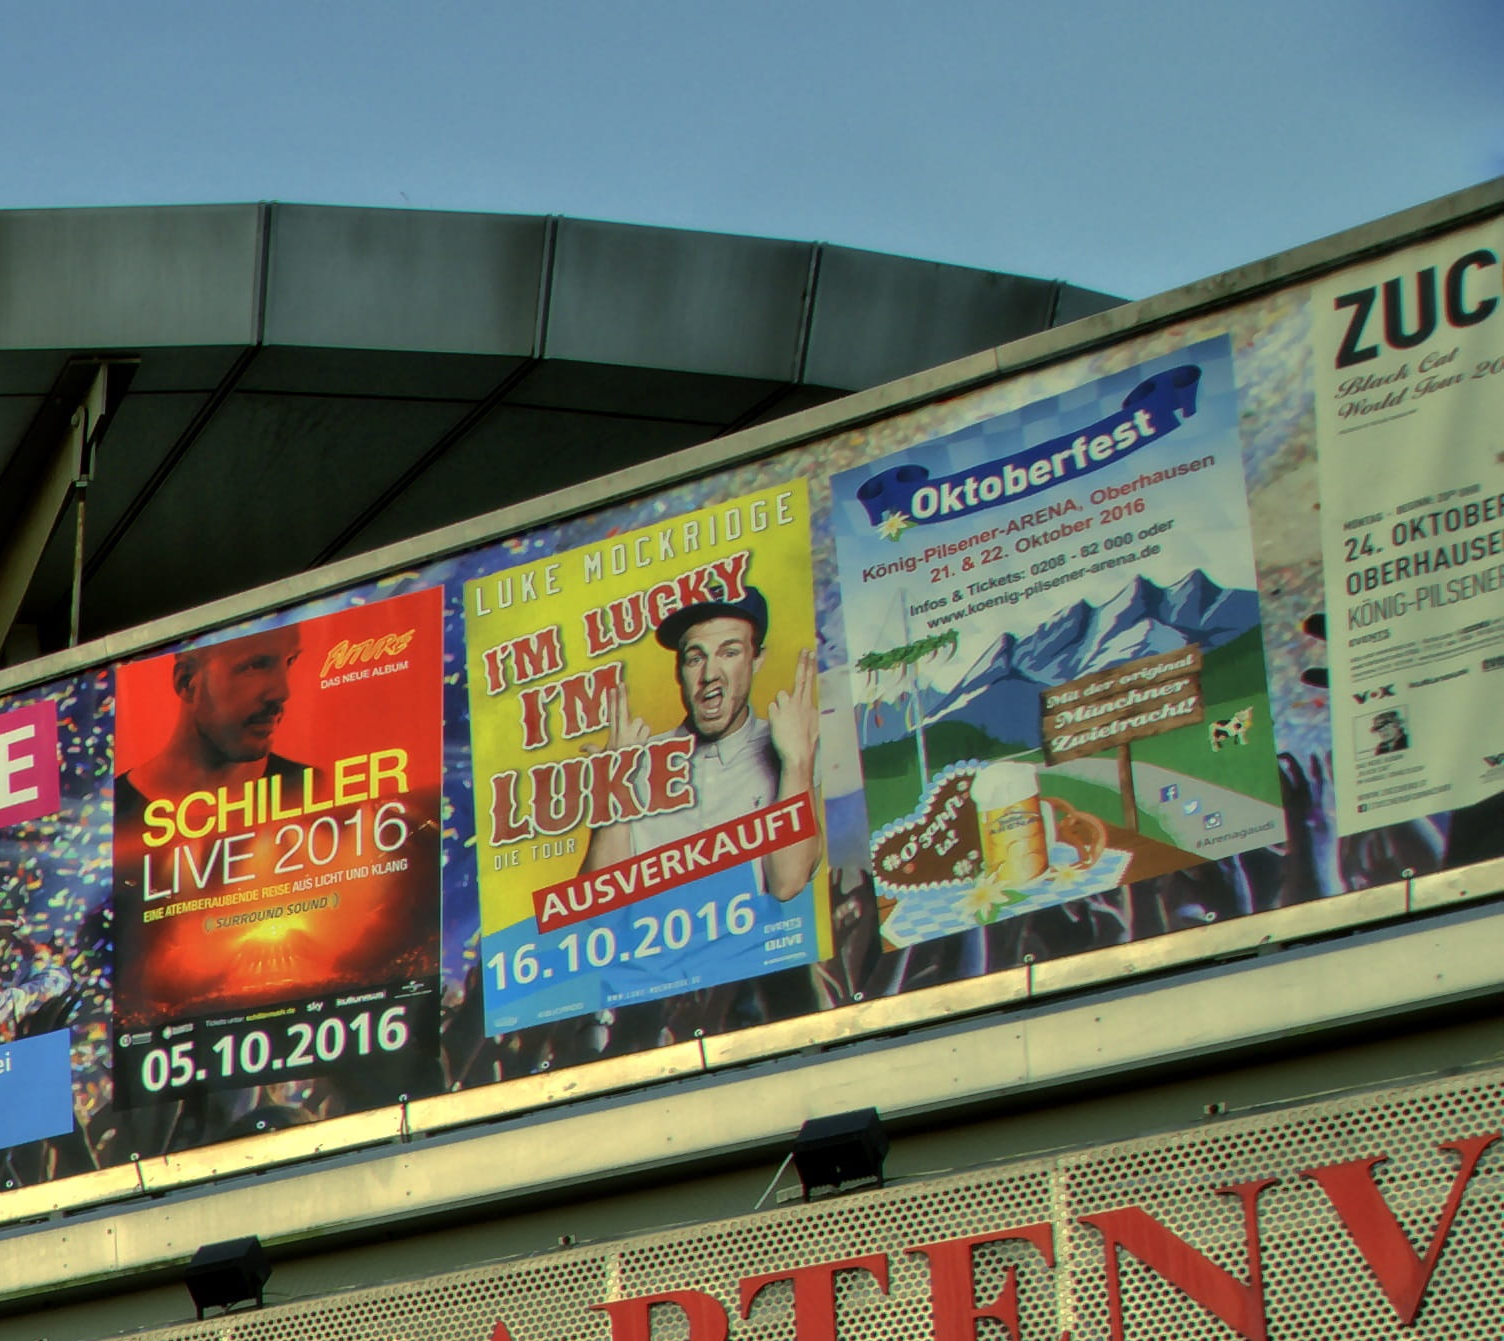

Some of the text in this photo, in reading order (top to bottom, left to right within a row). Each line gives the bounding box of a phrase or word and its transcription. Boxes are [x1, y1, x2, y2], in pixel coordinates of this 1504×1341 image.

[1334, 347, 1459, 399] Black Cat
[1338, 373, 1465, 419] World Tour
[911, 408, 1156, 520] Oktoberfest
[476, 490, 795, 617] LUKE MOCKRIDGE
[862, 454, 1216, 583] König-Pilsener-ARENA, Oberhausen
[930, 498, 1146, 584] 21. & 22. Oktober 2016
[1344, 533, 1383, 563] 24.
[910, 517, 1174, 617] Infos & Tickets: 000 oder
[927, 543, 1160, 629] www.koenig-pilsener-arena.de
[1346, 528, 1504, 596] OBERHAUSE
[483, 550, 750, 697] I'M LUCKY
[321, 660, 408, 689] DAS NEUE ALBUM
[520, 661, 624, 751] I'M
[1046, 653, 1194, 709] Mit der original
[1055, 678, 1191, 729] Münchner
[1051, 696, 1197, 753] Zwietracht!
[142, 748, 408, 847] SCHILLER
[489, 734, 696, 847] LUKE
[143, 803, 408, 901] LIVE 2016
[493, 838, 577, 872] DIE TOUR
[541, 799, 807, 924] AUSVERKAUFT
[1196, 820, 1275, 849] #Arenagaudi
[143, 858, 408, 923] EINE ATEMBERAUBENDE REISE AUS LICHT UND KLANG
[216, 897, 328, 928] SURROUND SOUND
[487, 892, 756, 991] 16.10.2016
[141, 1005, 409, 1093] 05.10.2016
